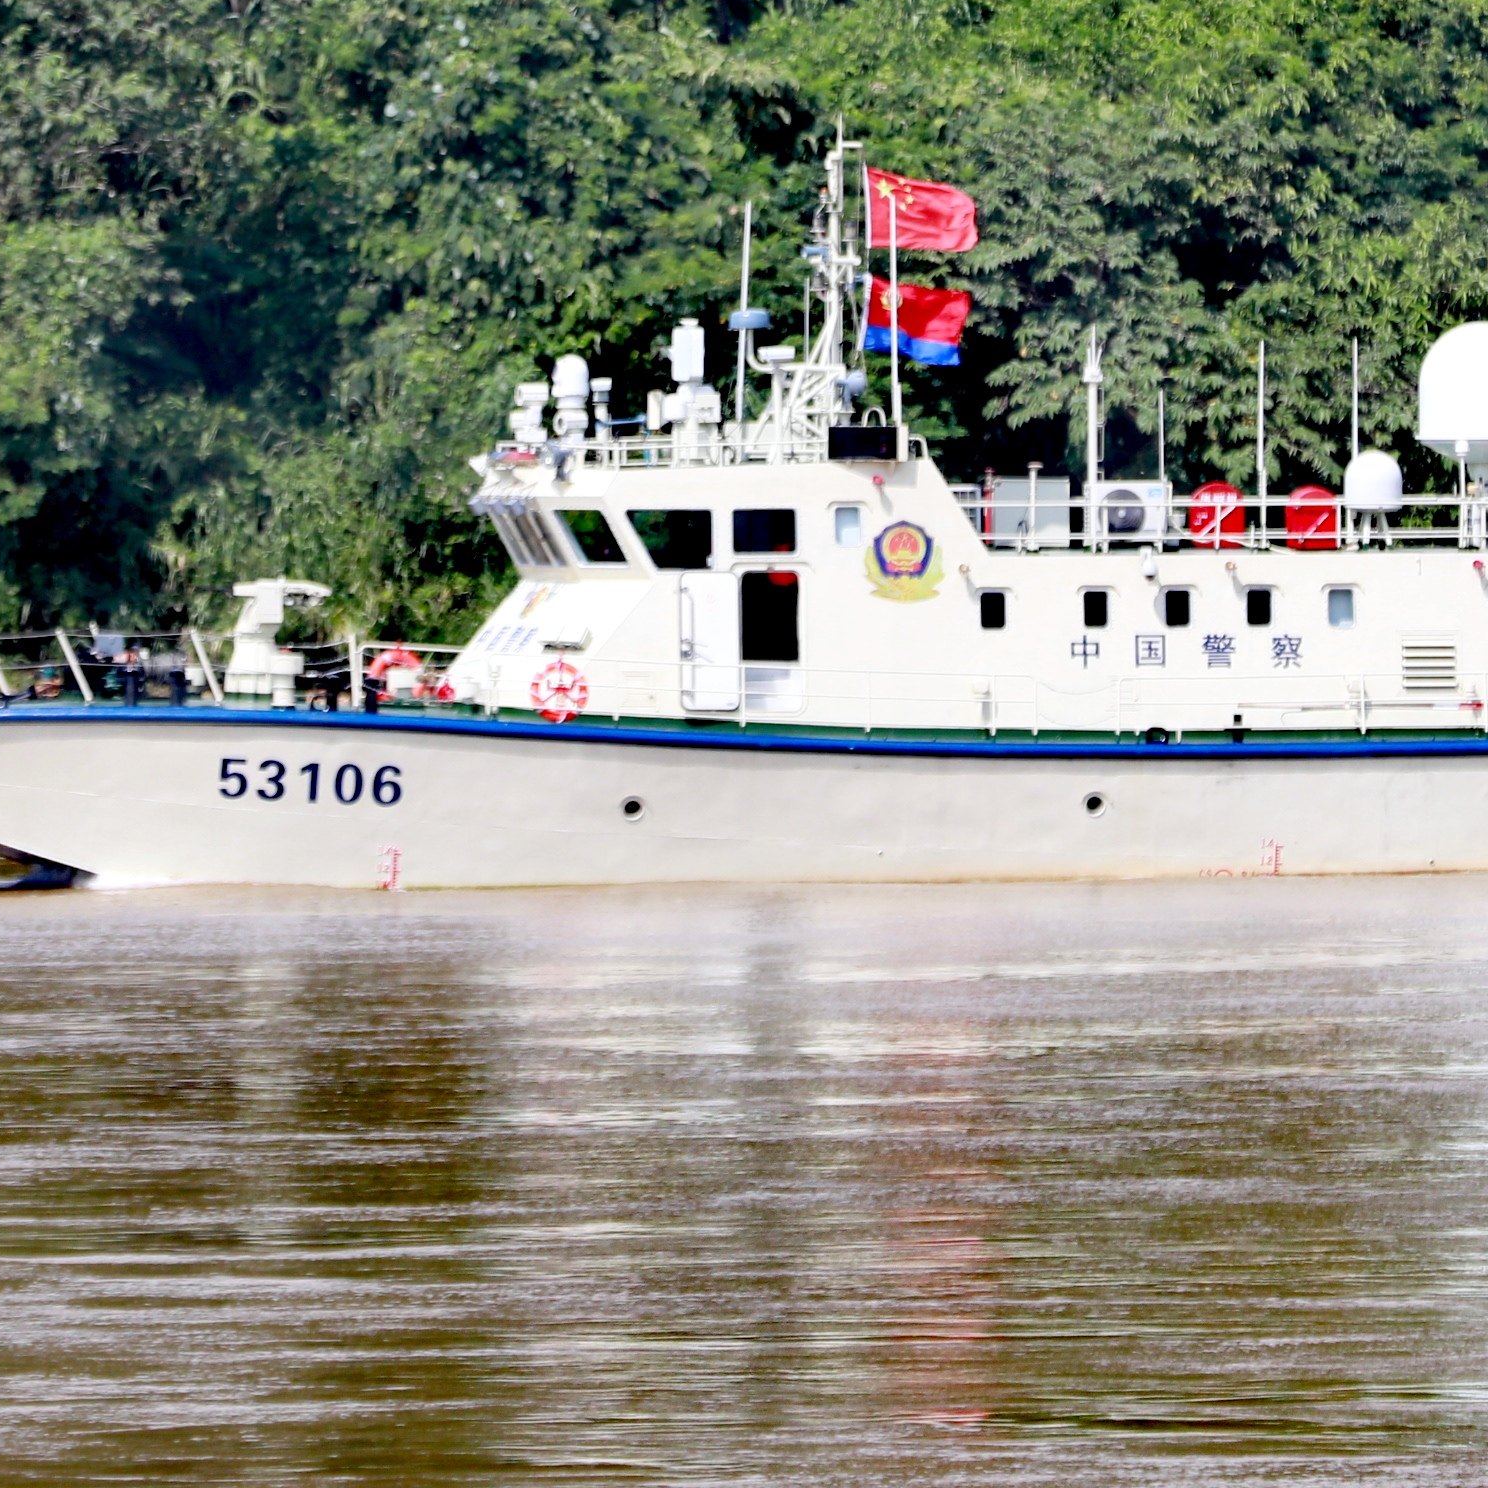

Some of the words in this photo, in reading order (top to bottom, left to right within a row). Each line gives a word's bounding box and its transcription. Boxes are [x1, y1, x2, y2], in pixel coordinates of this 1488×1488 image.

[1070, 634, 1303, 669] 中国警察
[219, 758, 403, 806] 53106
